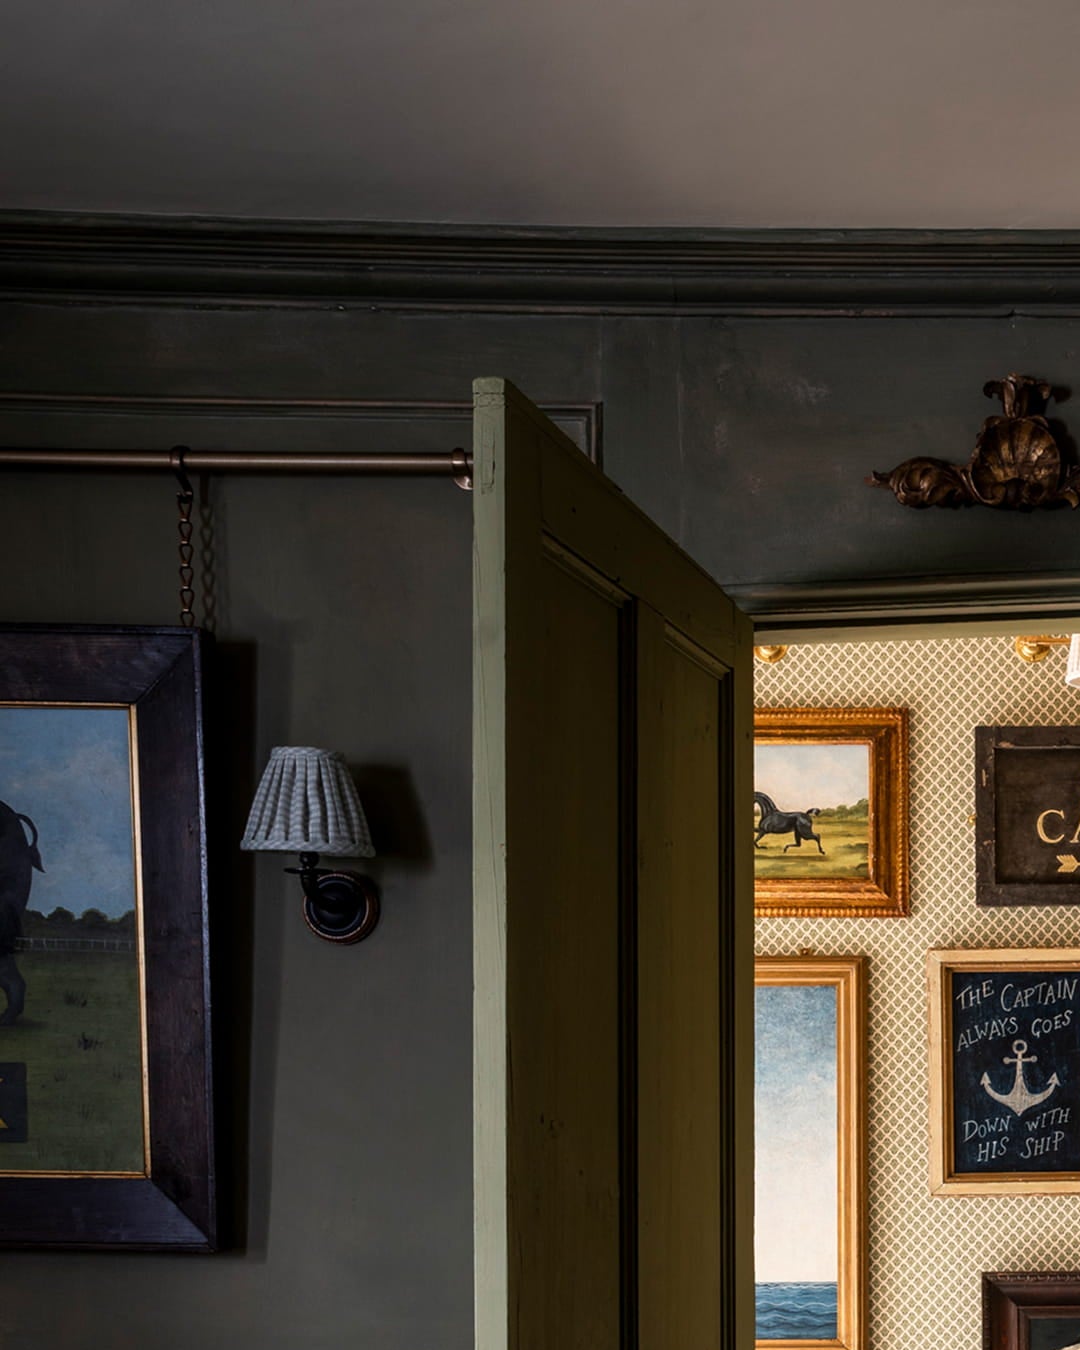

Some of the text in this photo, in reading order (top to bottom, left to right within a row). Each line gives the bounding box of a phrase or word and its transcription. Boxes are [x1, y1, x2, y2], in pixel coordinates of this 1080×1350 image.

[955, 978, 1079, 1012] THE CAPTAIN
[956, 1009, 1073, 1052] ALWAYS GOES
[962, 1107, 1071, 1142] DOWN WITH
[977, 1130, 1065, 1162] HIS SHIP
